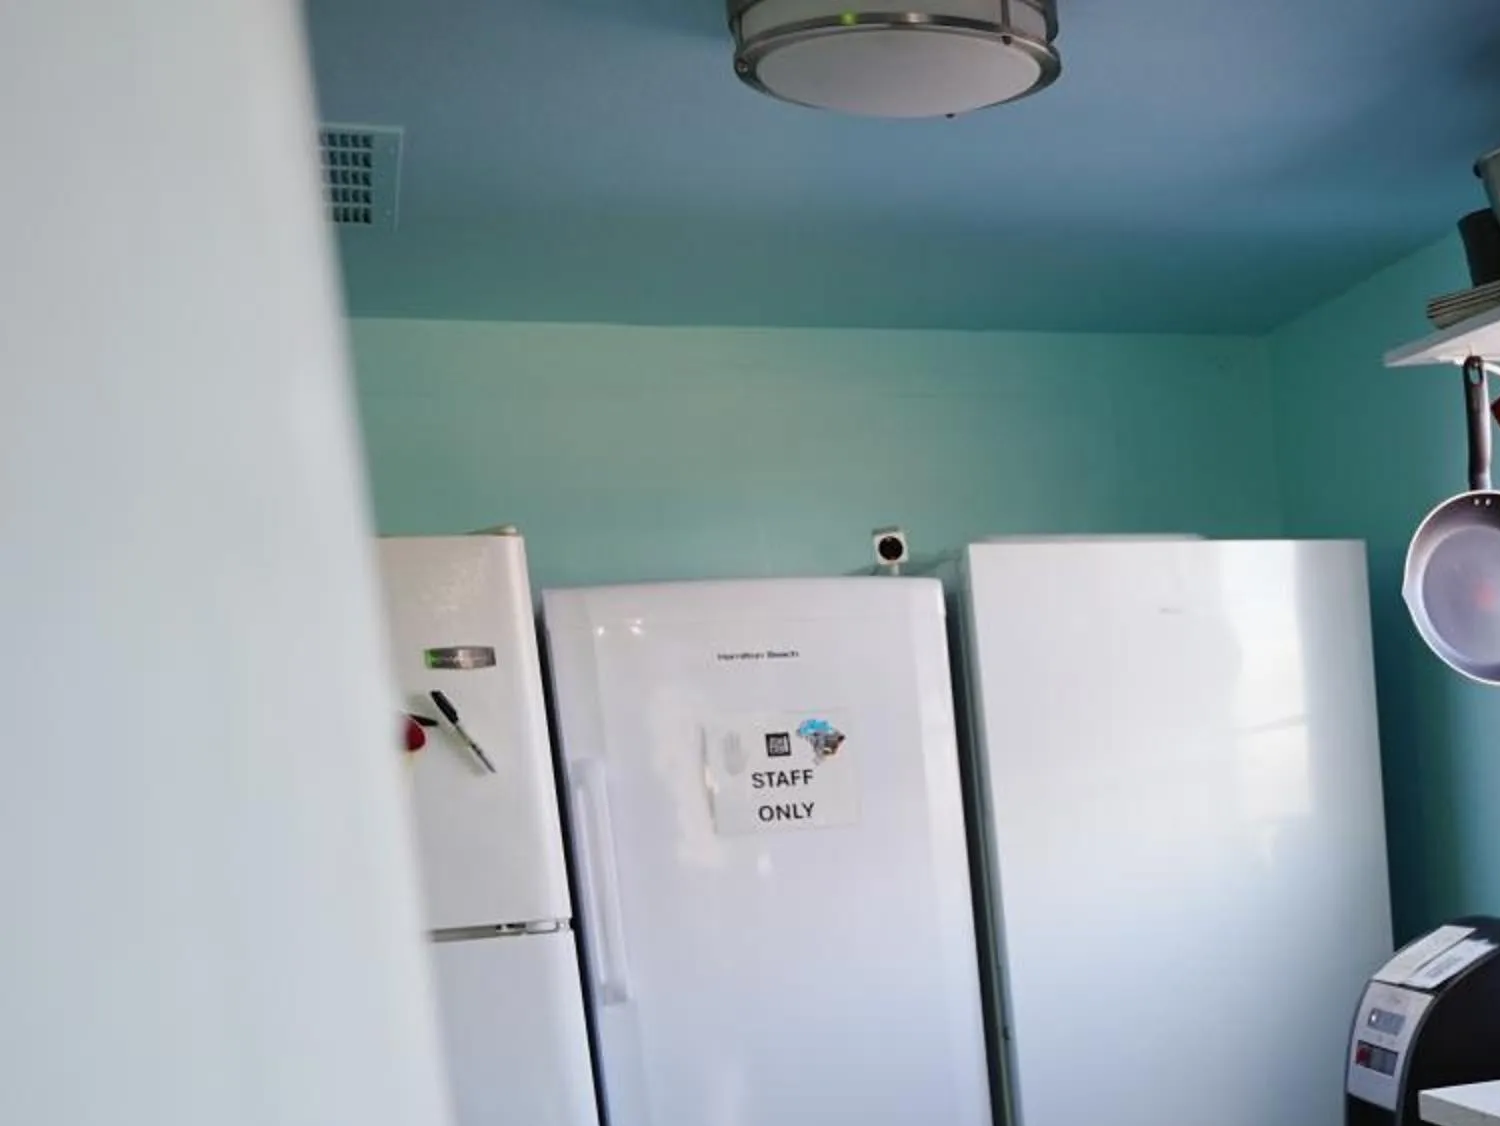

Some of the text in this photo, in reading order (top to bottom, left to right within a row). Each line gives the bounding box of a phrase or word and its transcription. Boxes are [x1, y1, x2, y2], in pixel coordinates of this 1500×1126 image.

[767, 650, 799, 660] Beach
[751, 768, 814, 789] STAFF
[757, 801, 815, 822] ONLY
